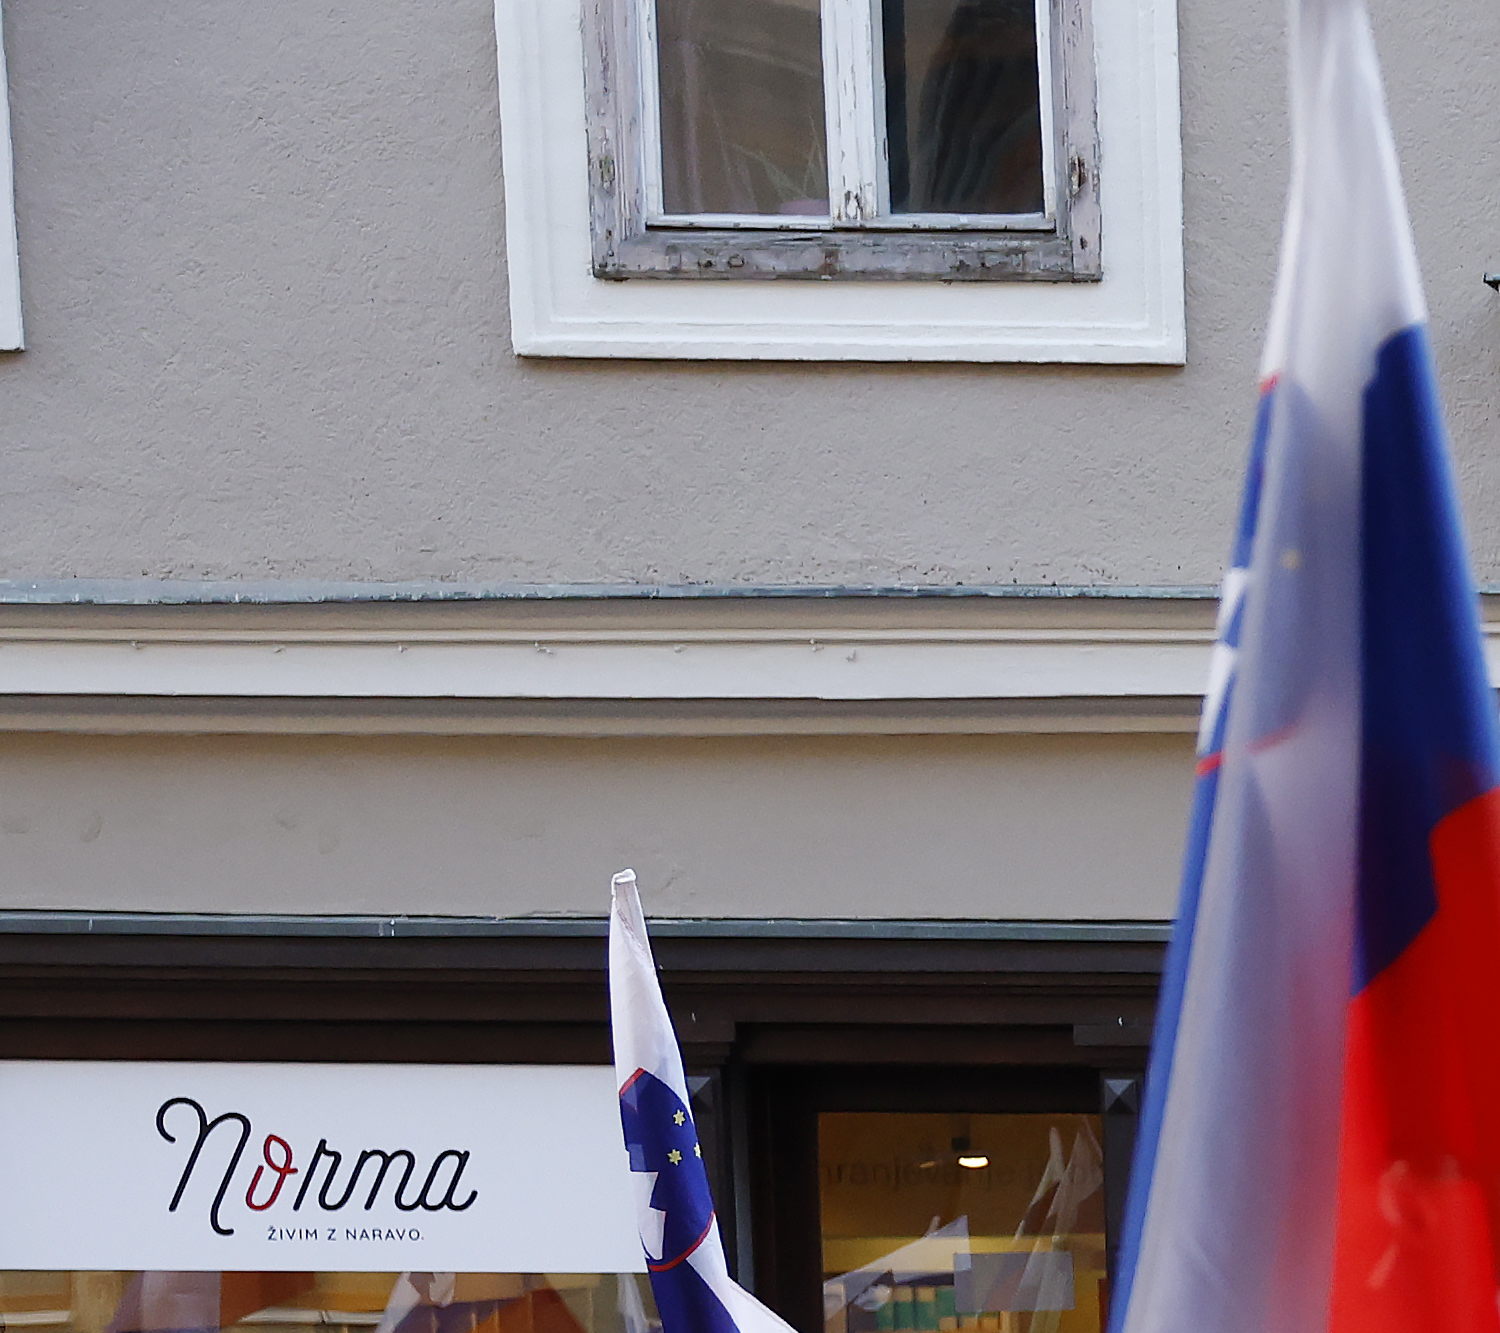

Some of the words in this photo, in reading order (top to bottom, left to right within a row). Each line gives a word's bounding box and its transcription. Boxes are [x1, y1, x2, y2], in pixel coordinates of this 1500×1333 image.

[155, 1096, 478, 1236] Norma
[266, 1225, 318, 1242] ŽIVIM
[327, 1228, 338, 1242] Z
[345, 1227, 425, 1242] NARAVO.
